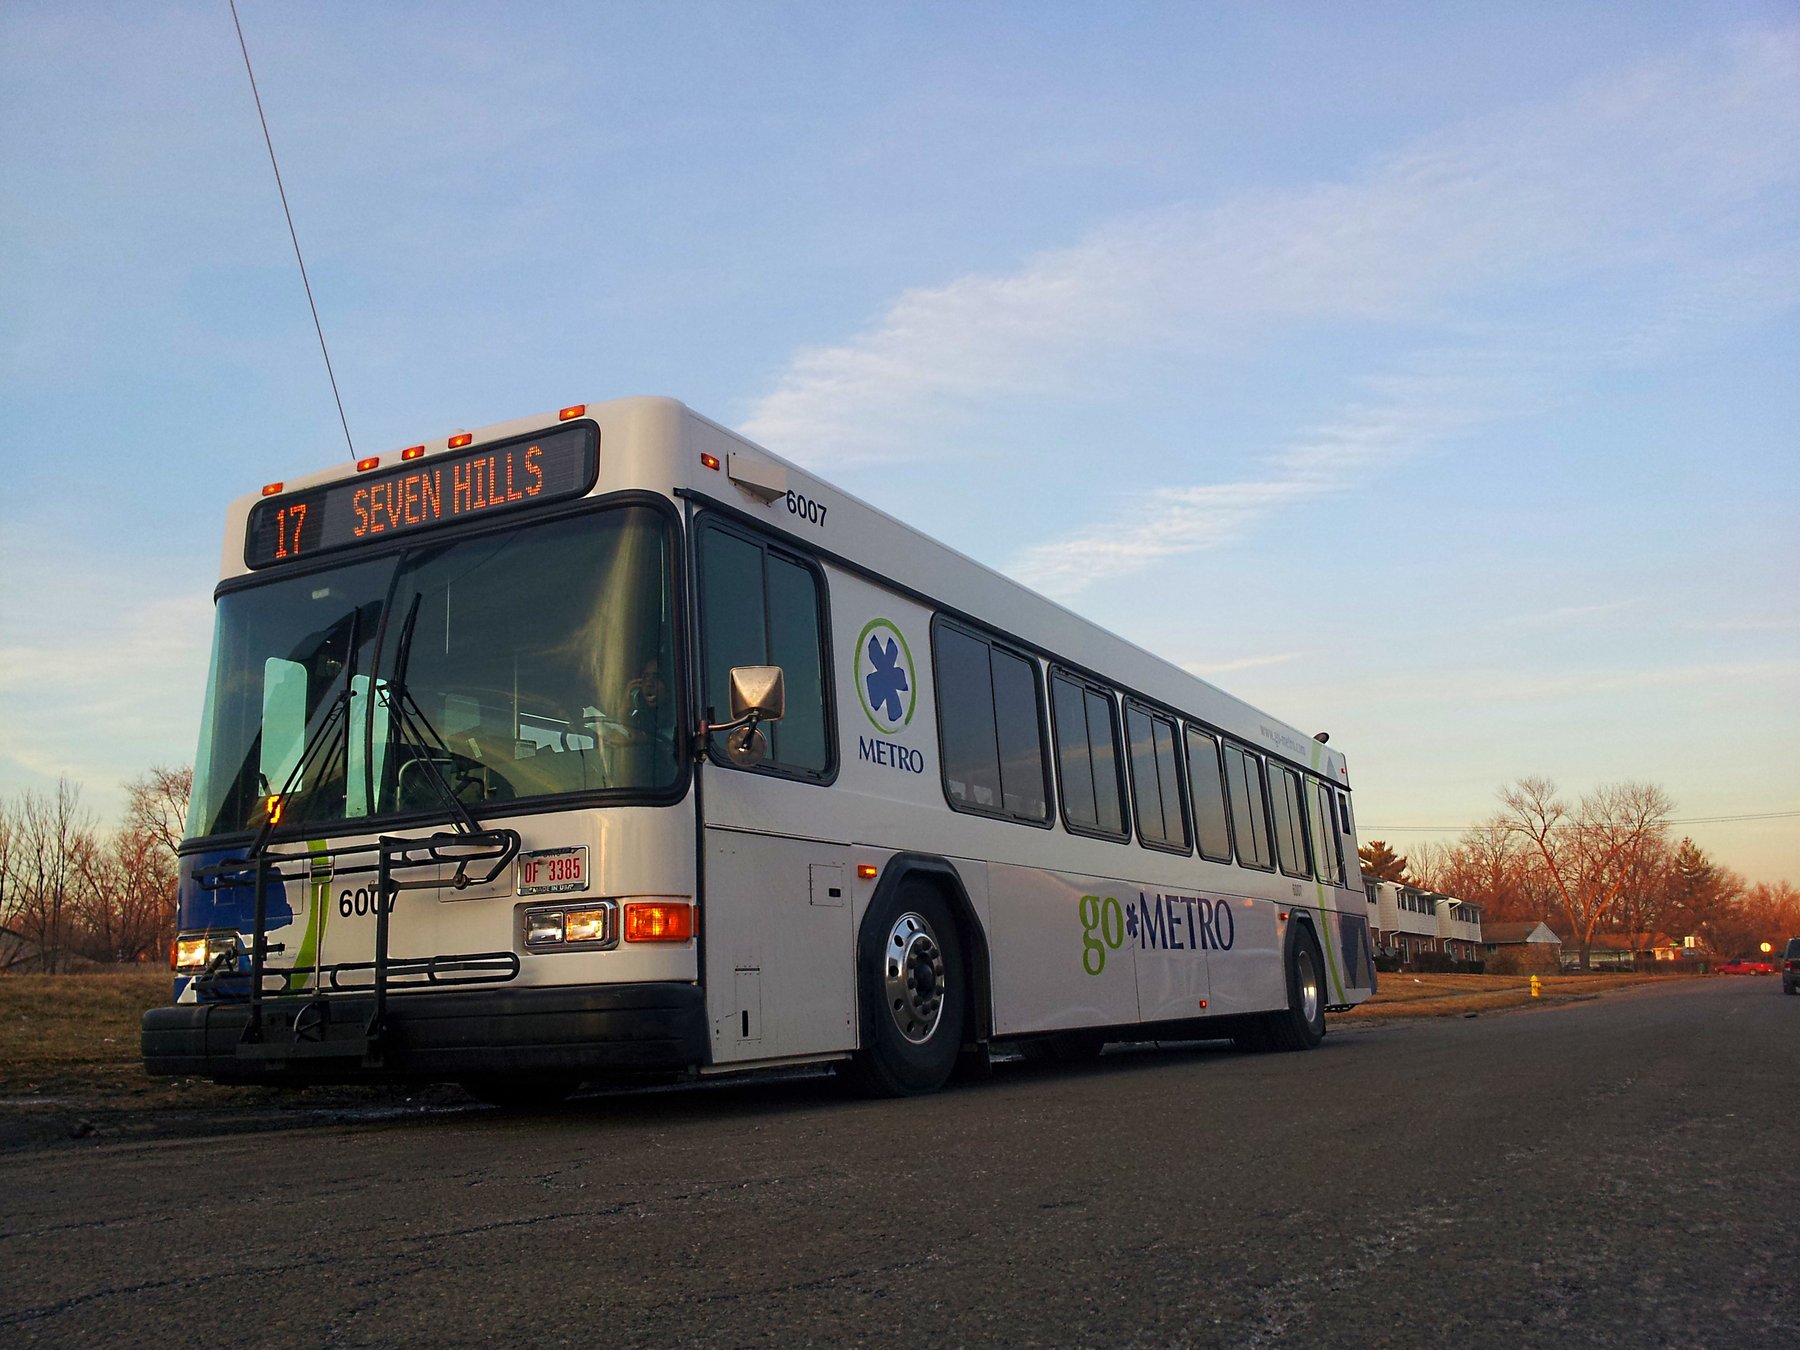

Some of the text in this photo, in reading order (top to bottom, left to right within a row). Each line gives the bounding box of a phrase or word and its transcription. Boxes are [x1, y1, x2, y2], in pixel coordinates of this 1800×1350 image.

[273, 445, 542, 559] 17 SEVEN HILLS
[786, 489, 827, 527] 6007
[859, 735, 924, 774] METRO
[549, 857, 580, 881] 3385
